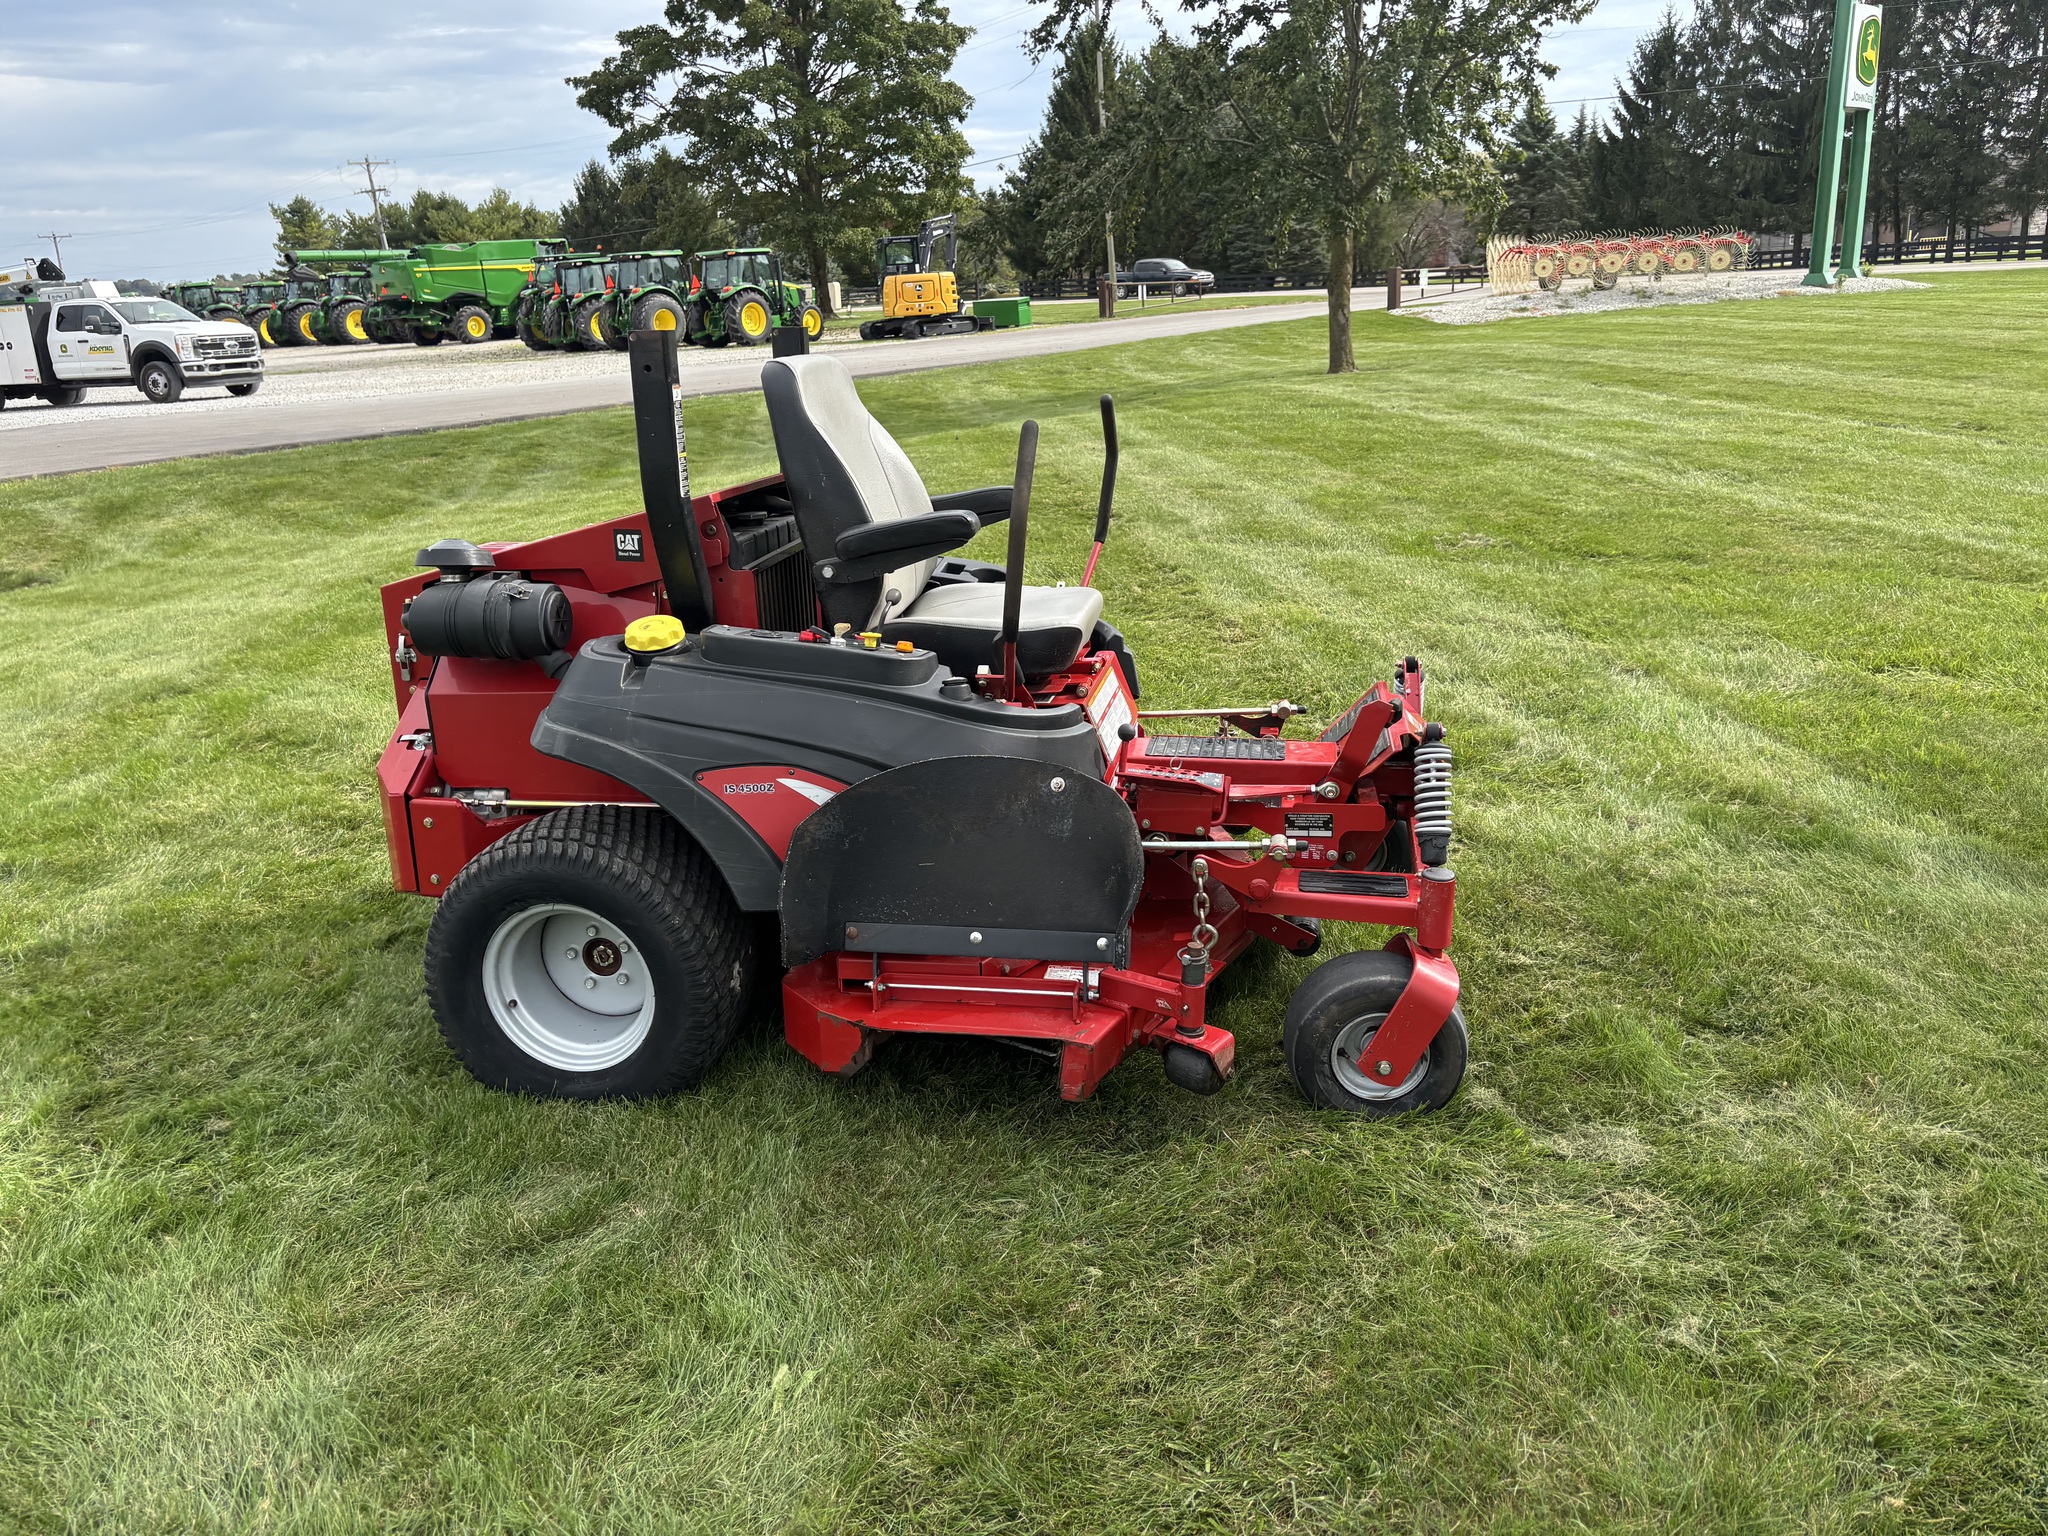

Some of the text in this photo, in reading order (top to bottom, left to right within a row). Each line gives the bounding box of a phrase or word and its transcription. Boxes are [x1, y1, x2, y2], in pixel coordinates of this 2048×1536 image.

[616, 534, 639, 551] CAT
[724, 783, 775, 794] IS 4500Z
